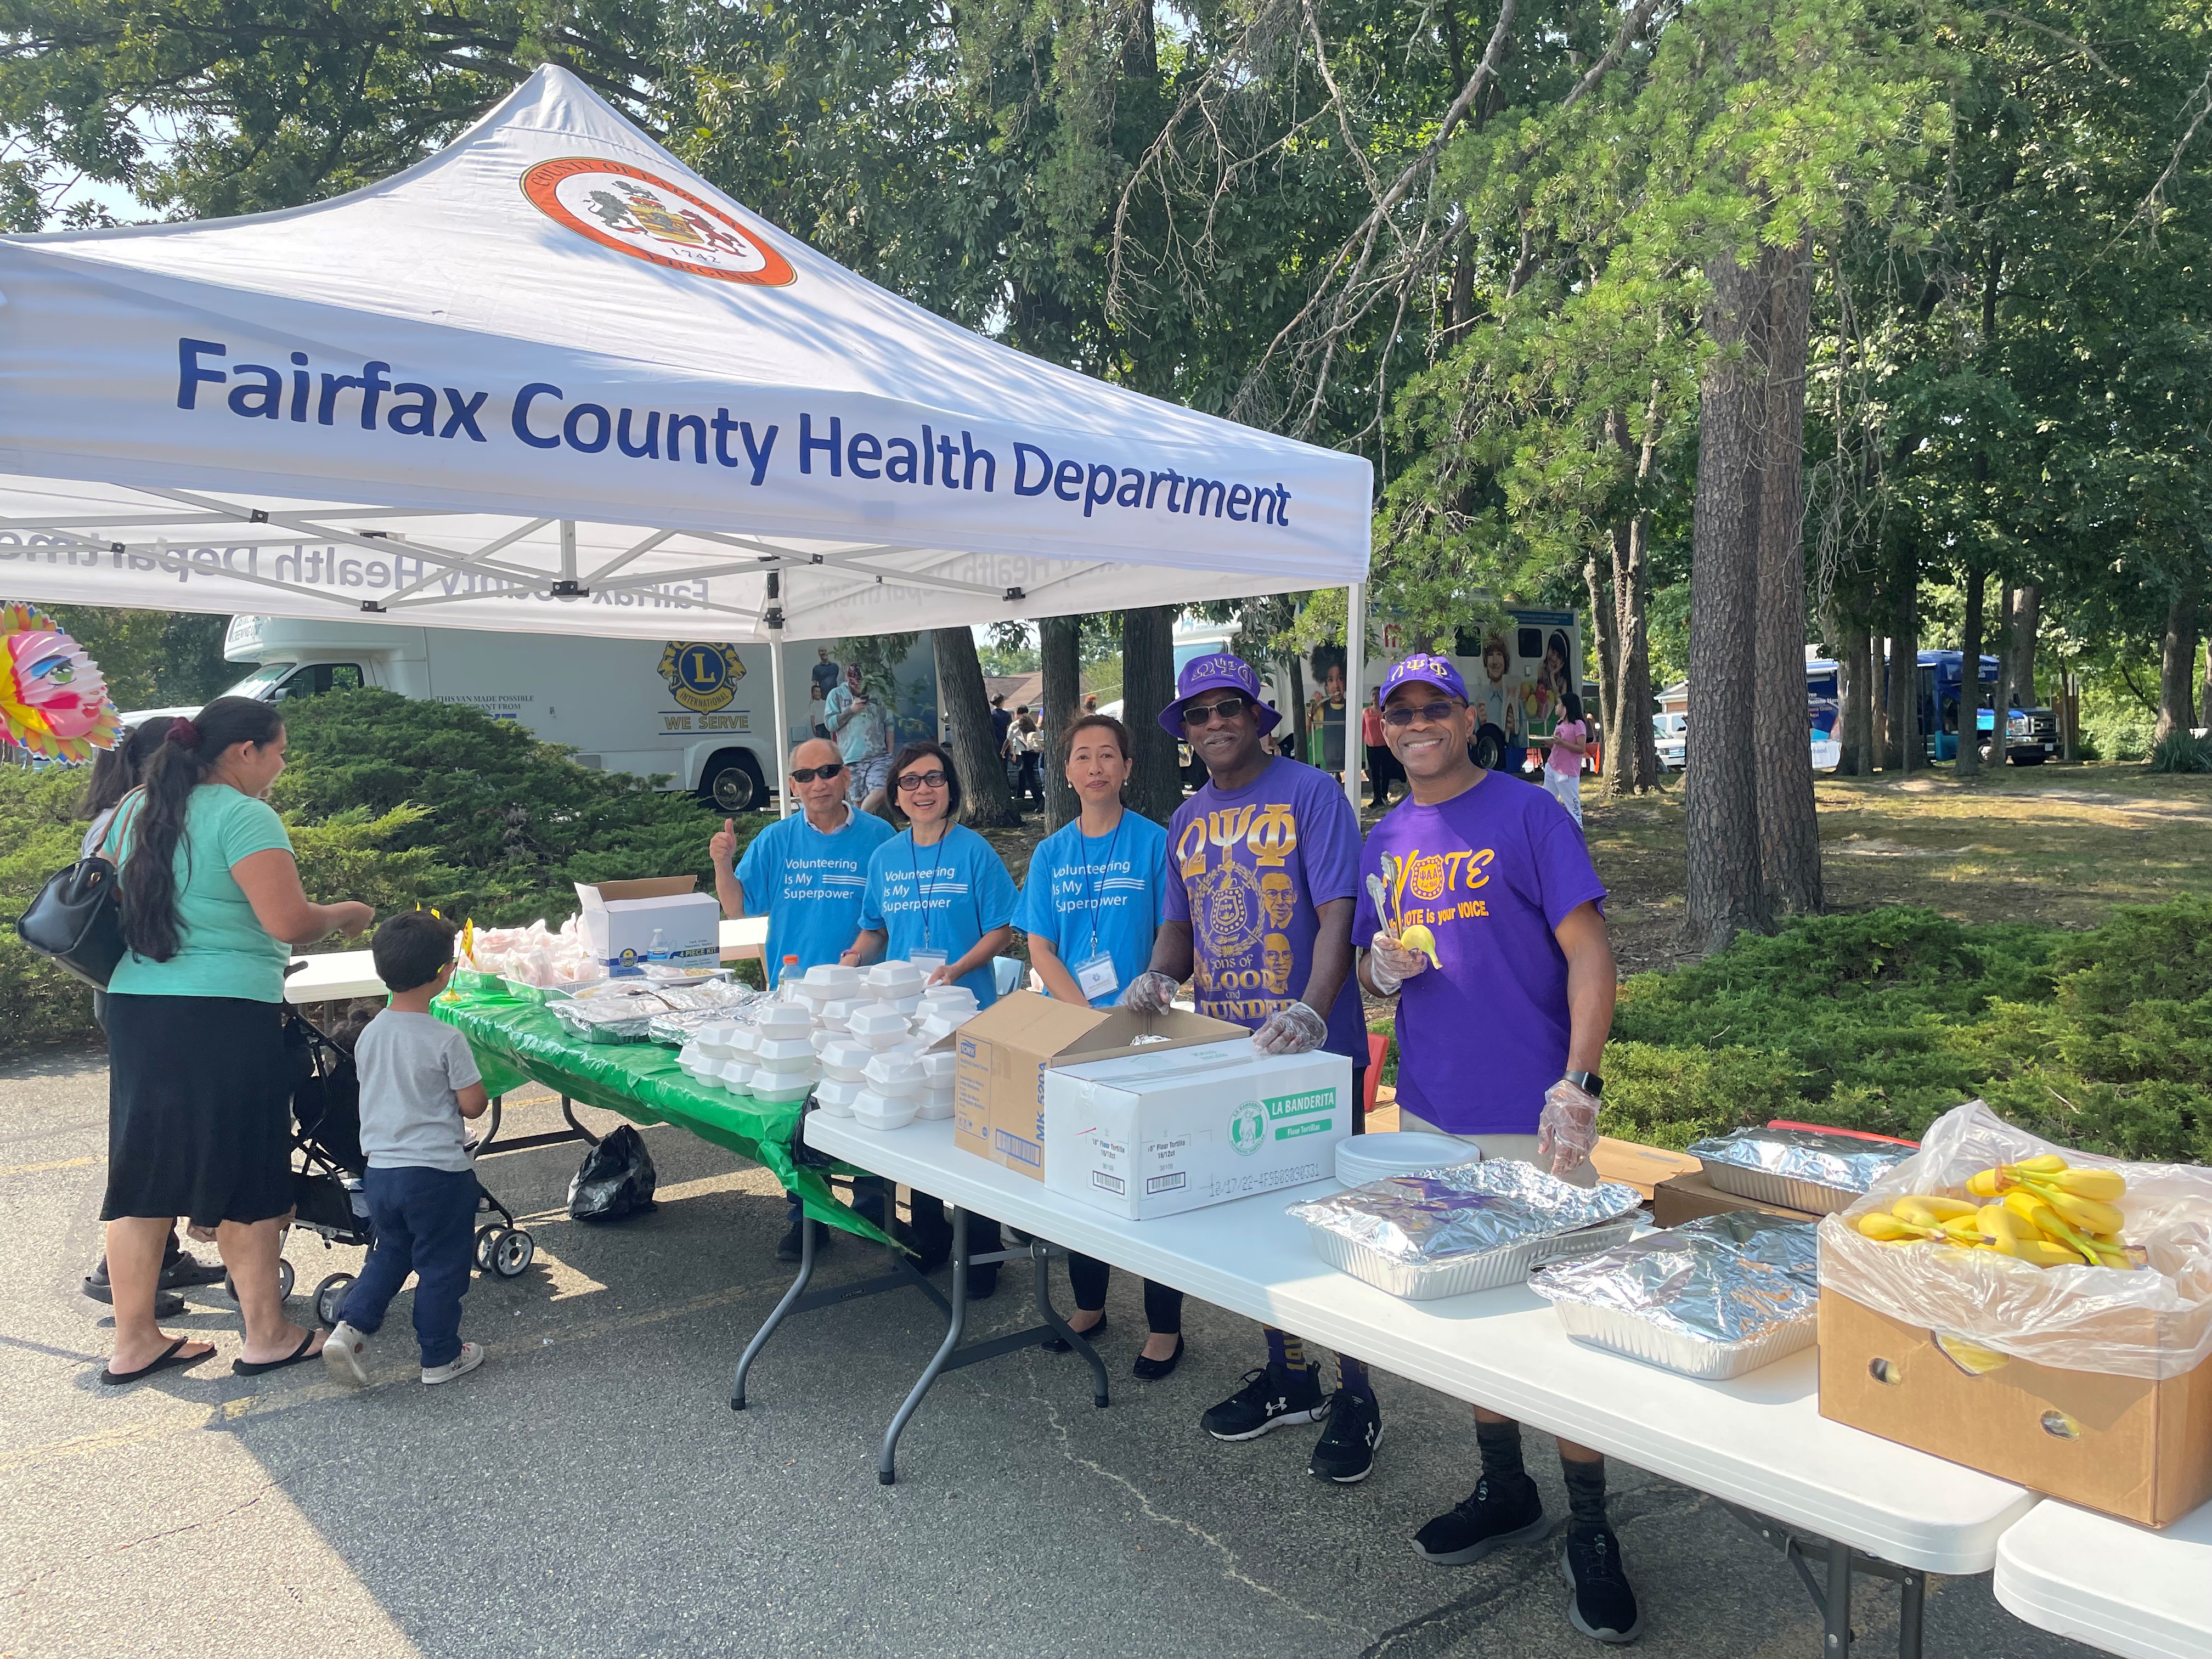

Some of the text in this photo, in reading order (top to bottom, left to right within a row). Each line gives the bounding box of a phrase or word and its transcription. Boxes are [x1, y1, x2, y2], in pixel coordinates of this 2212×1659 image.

[531, 160, 592, 187] COUNTY
[602, 162, 631, 174] OF
[671, 246, 721, 264] 1742
[647, 252, 766, 283] VIRGINIA
[177, 337, 1292, 528] Fairfax County Health Department
[692, 653, 716, 682] L
[679, 691, 729, 708] INTERNATIONAL
[664, 715, 748, 730] WE SERVE
[1176, 804, 1297, 879] ΩΨΦ
[785, 857, 857, 872] Volunteering
[1053, 860, 1131, 879] Volunteering
[785, 873, 812, 887] Is My
[885, 866, 956, 882] Volunteering
[784, 888, 854, 901] Superpower
[884, 884, 910, 899] Is My
[1053, 880, 1082, 896] Is My
[883, 898, 951, 913] Superpower
[1056, 895, 1128, 913] Superpower
[1426, 908, 1435, 924] is
[1437, 907, 1455, 926] your
[1457, 900, 1490, 919] VOICE.
[686, 948, 706, 957] PIECE
[1239, 954, 1254, 969] of
[1226, 990, 1240, 1000] and
[961, 1043, 976, 1057] TORK
[1272, 1092, 1334, 1116] LA BANDERITA
[1287, 1123, 1321, 1137] Flour Tortillas
[1099, 1140, 1110, 1149] Flour
[1111, 1143, 1125, 1154] Tortilla
[1156, 1143, 1169, 1151] Flour
[1169, 1139, 1186, 1148] Tortilla
